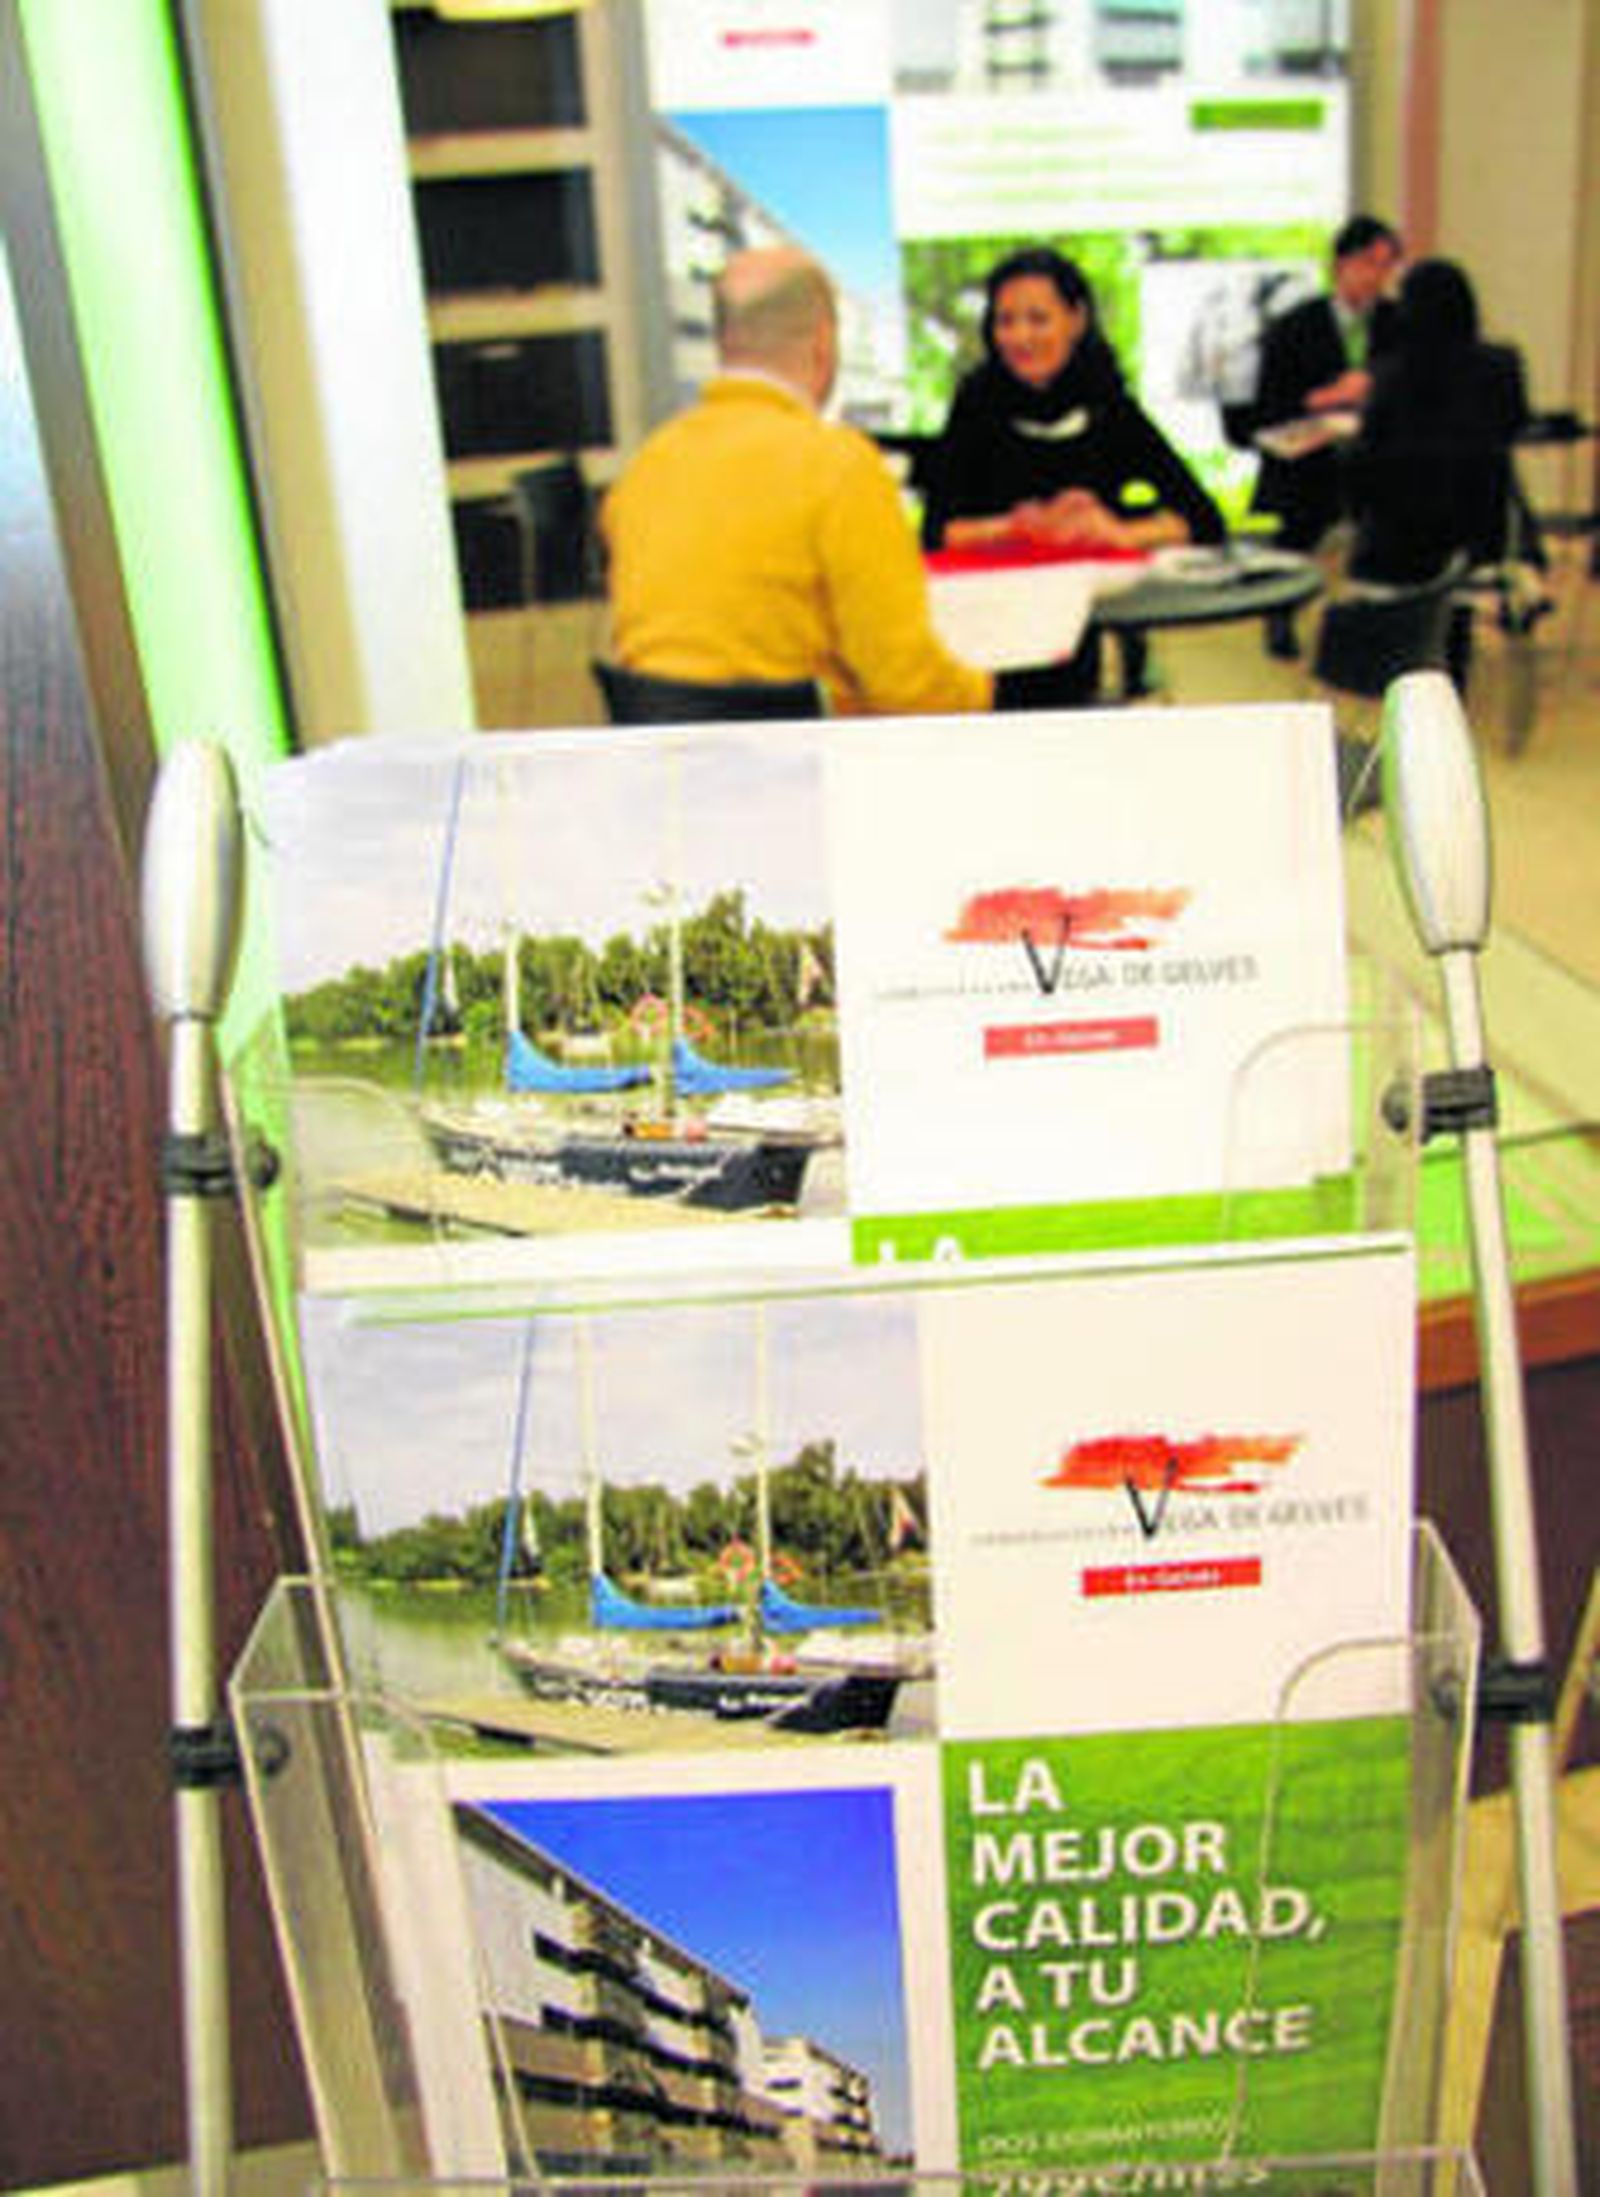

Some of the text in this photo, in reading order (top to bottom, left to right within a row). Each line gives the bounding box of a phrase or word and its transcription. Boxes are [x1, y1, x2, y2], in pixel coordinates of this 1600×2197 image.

[968, 1758, 1065, 1815] LA
[972, 1821, 1227, 1886] MEJOR
[972, 1887, 1329, 1951] CALIDAD,
[976, 1958, 1138, 2012] A TU
[978, 2005, 1313, 2070] ALCANCE
